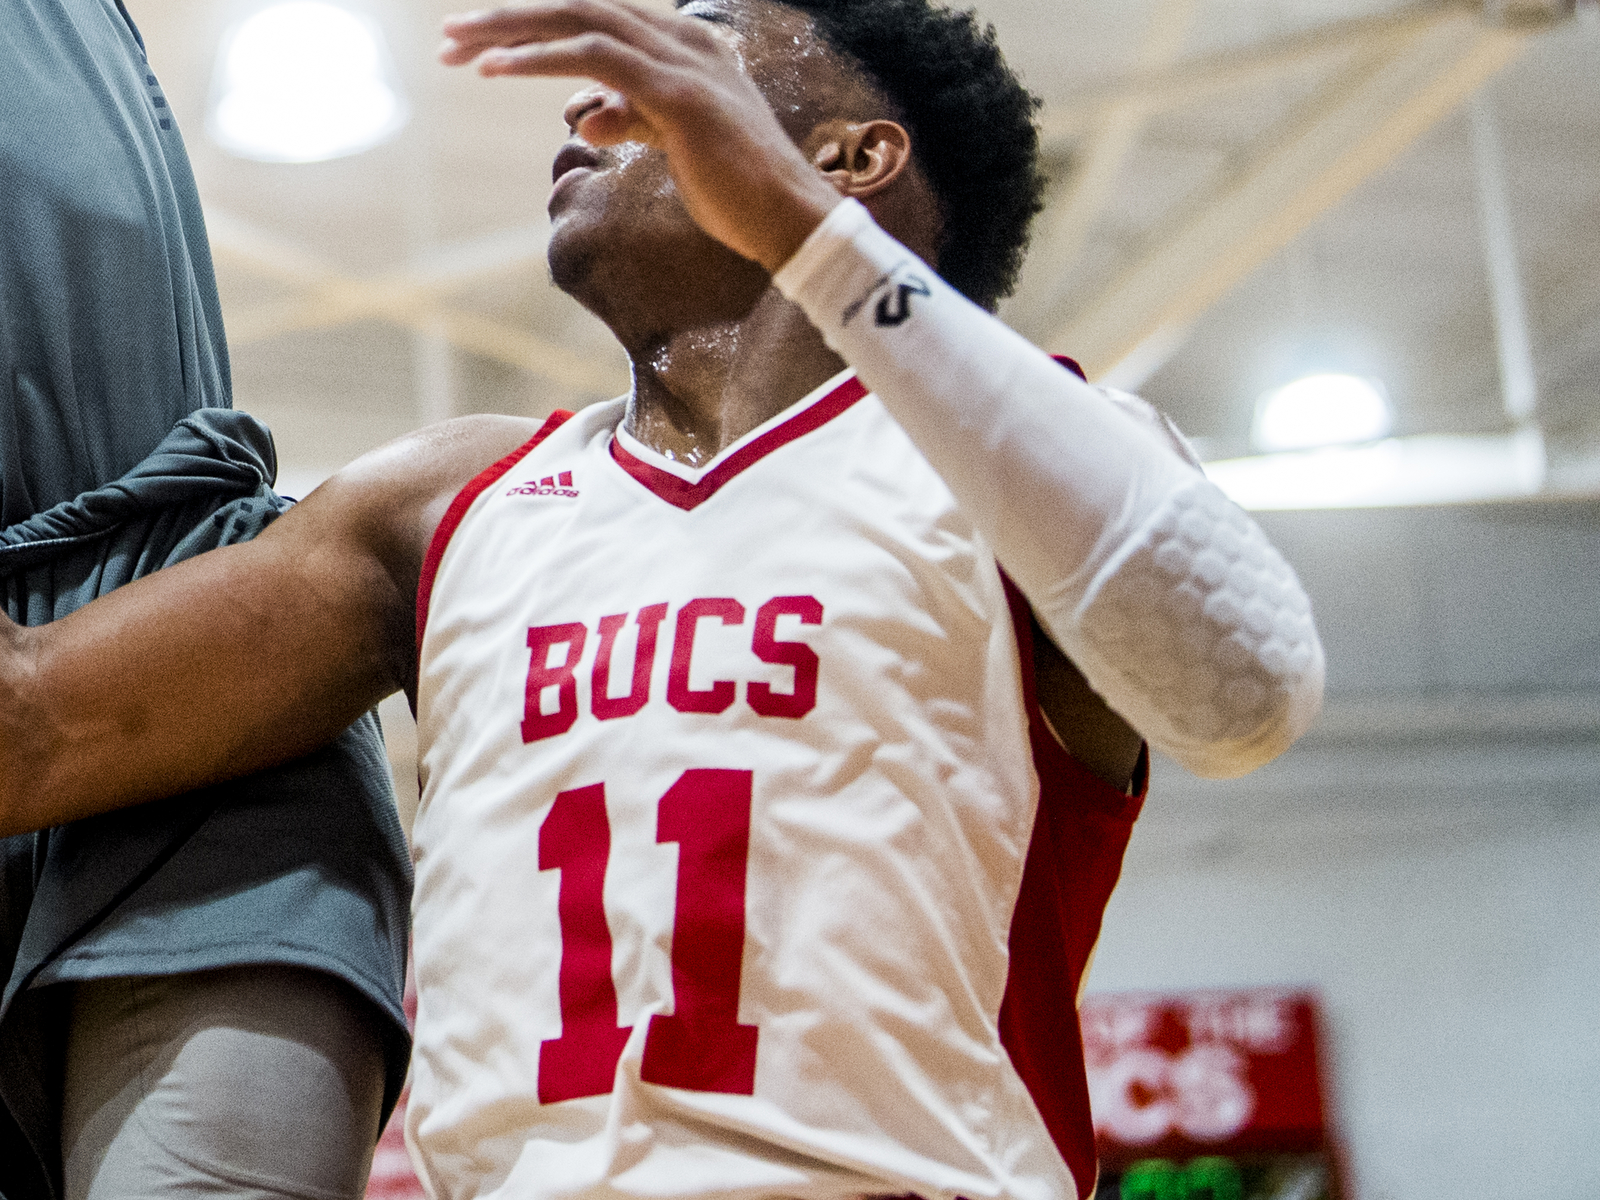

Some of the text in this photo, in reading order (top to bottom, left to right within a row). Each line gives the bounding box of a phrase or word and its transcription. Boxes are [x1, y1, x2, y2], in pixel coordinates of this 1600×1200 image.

[520, 594, 824, 745] BUCS
[536, 767, 759, 1105] 11
[1088, 1048, 1254, 1144] CS
